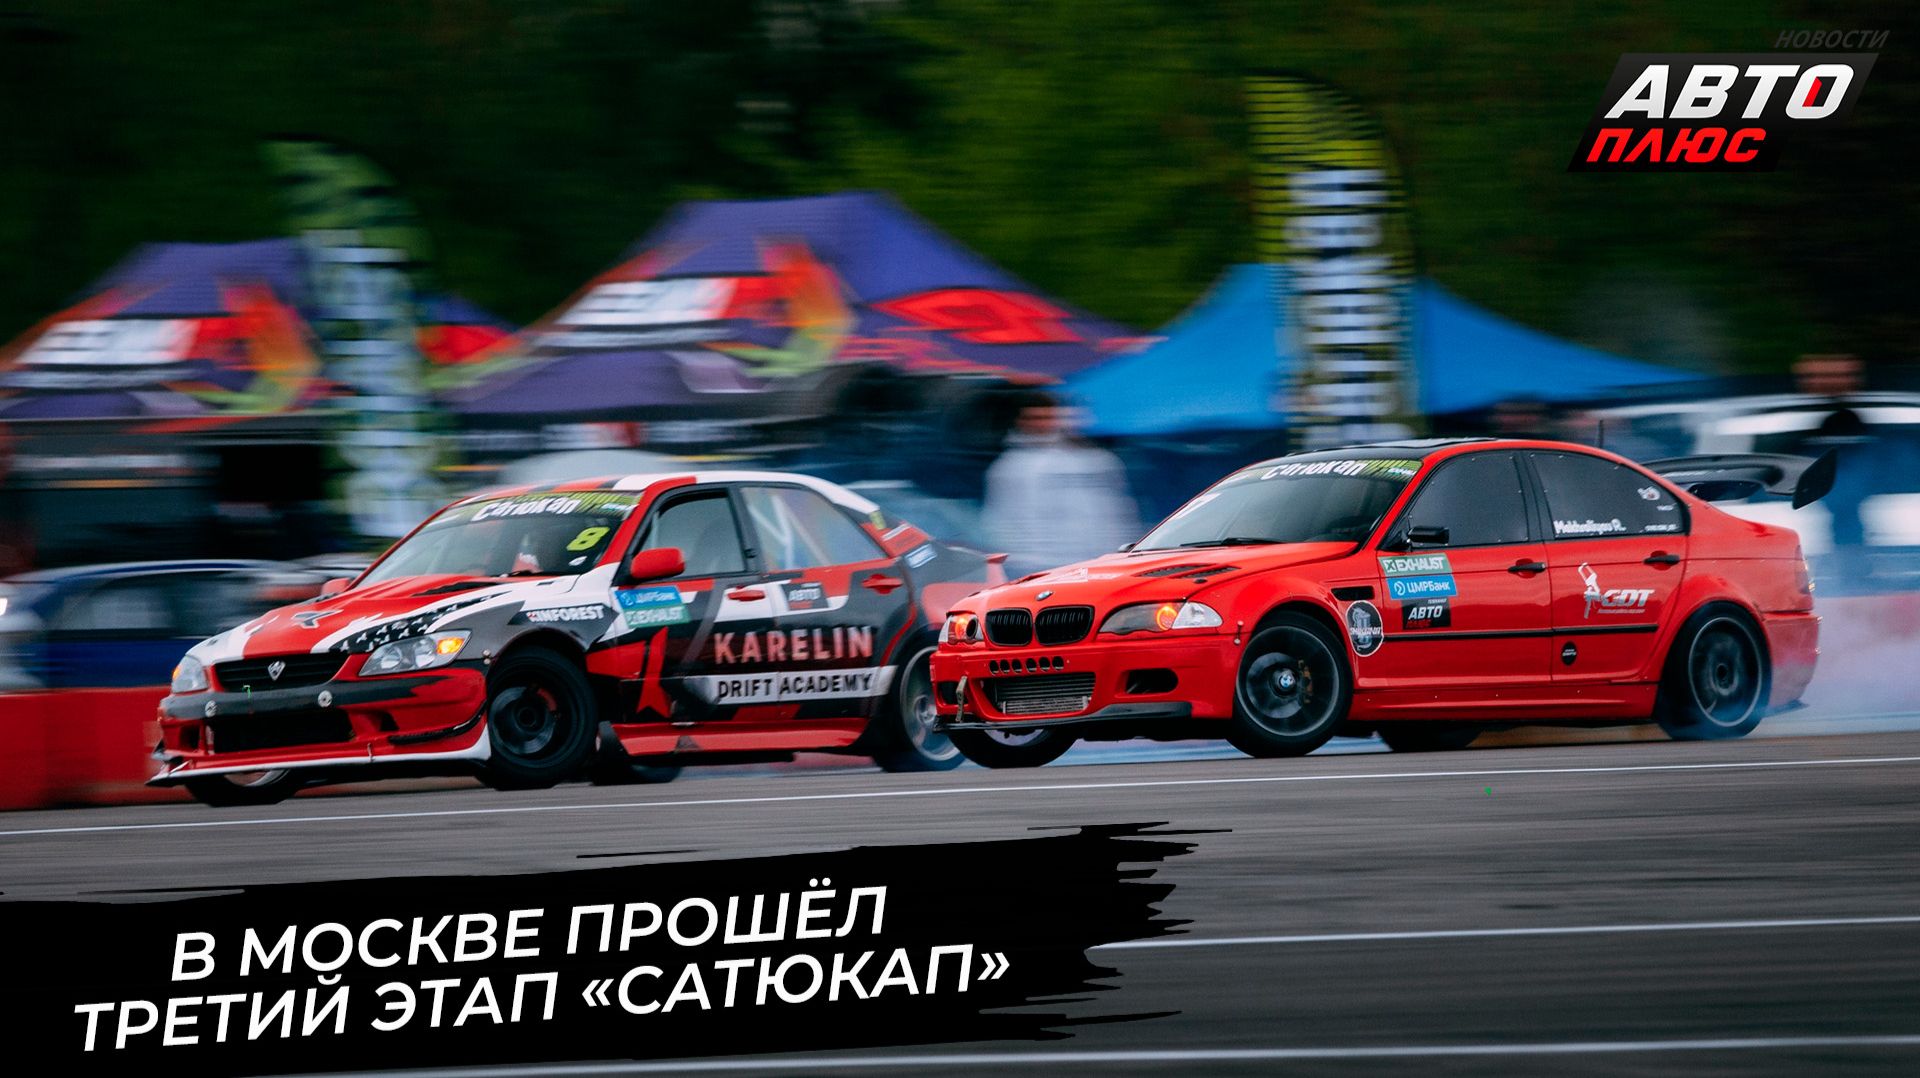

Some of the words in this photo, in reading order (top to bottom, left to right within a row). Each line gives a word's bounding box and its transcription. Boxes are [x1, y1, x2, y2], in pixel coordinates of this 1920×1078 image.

[566, 526, 610, 551] 8
[1406, 580, 1450, 594] ЦМРБанк
[1408, 605, 1443, 620] АВТО
[714, 625, 873, 665] KARELIN
[718, 678, 772, 699] DRIFT
[779, 673, 873, 695] ACADEMY
